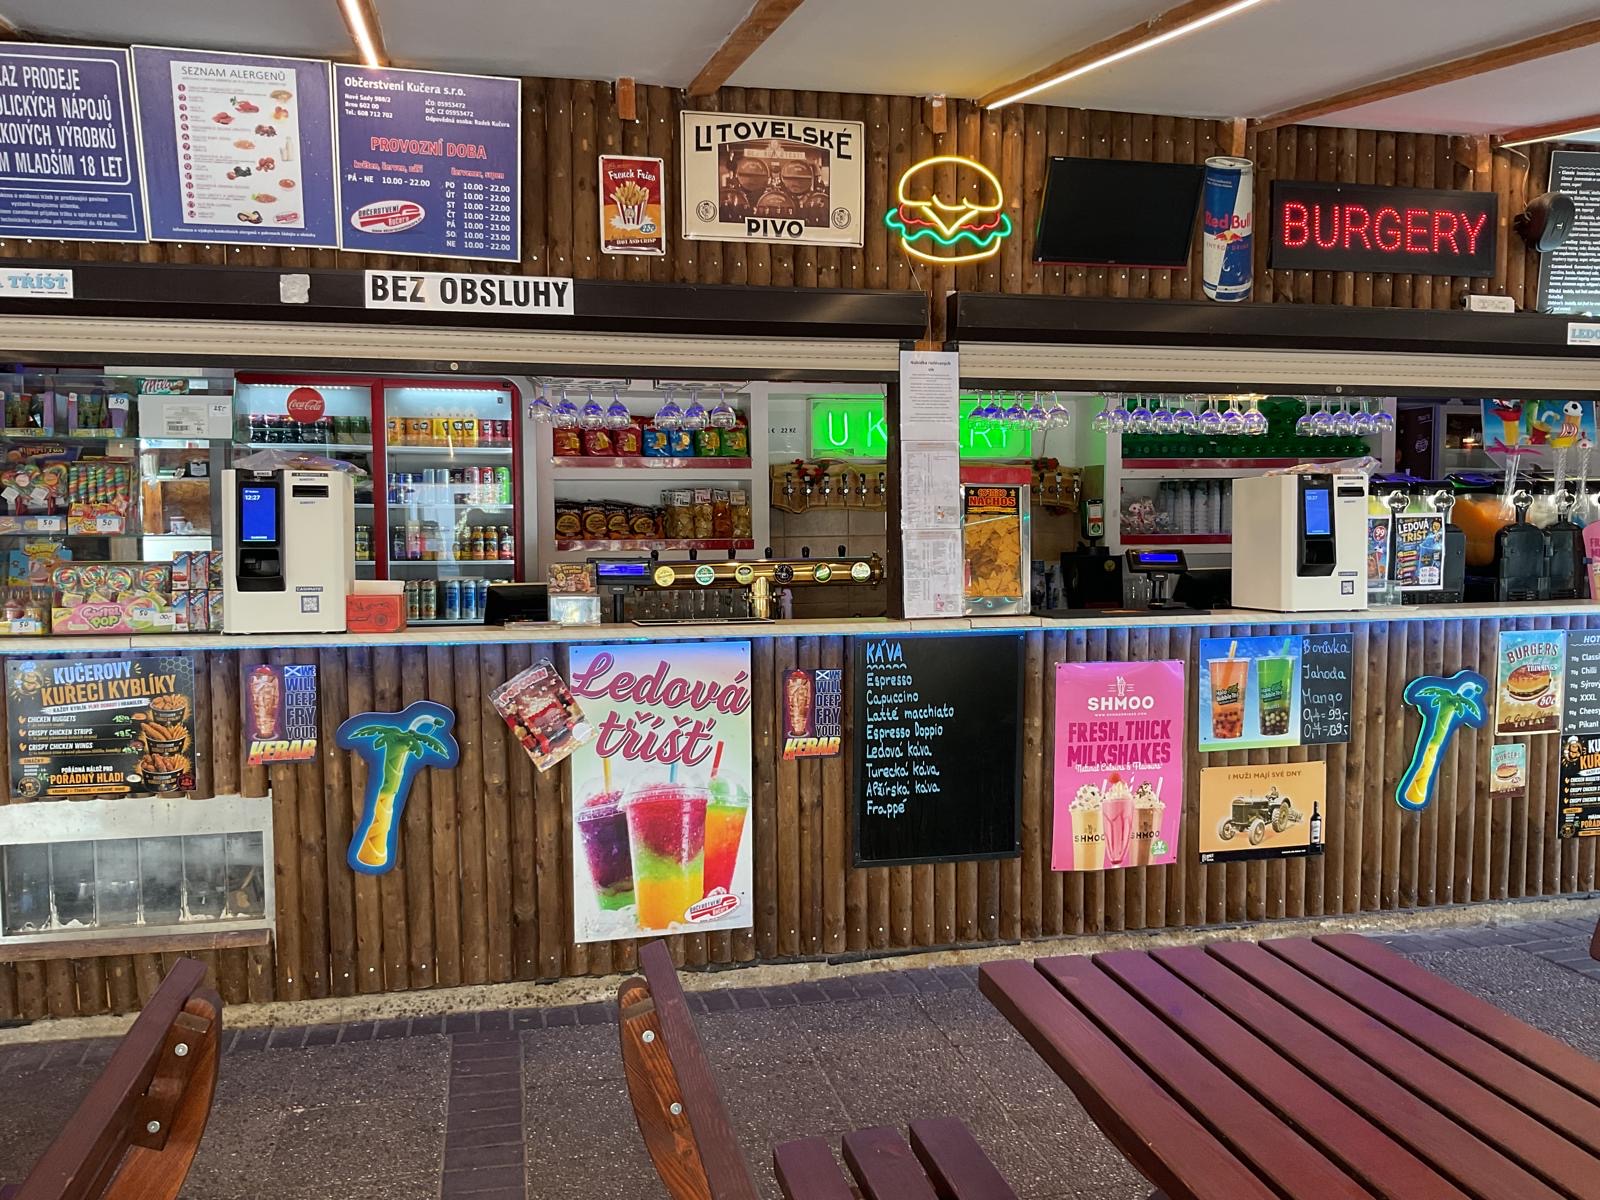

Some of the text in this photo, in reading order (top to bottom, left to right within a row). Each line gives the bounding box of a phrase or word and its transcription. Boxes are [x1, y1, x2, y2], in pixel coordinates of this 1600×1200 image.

[0, 64, 80, 90] AZ PRODEJE
[181, 66, 226, 78] SEZNAM
[230, 69, 286, 81] ALERGENŮ
[344, 76, 466, 96] Občerstvení Kučera s.r.o.
[61, 92, 112, 121] NÁPOJŮ
[437, 101, 466, 109] 05953472
[0, 119, 116, 149] KOVÝCH VÝROBKŮ
[695, 121, 852, 160] LITOVELSKÉ
[370, 136, 488, 160] PROVOZNÍ DOBA
[15, 148, 75, 176] MLADŠÍM
[80, 155, 95, 176] 18
[101, 156, 122, 177] LET
[354, 160, 424, 173] květen, červen, září
[348, 174, 431, 188] PÁ NE 10.00 22.00
[451, 167, 505, 180] červenec, srpen
[608, 168, 656, 181] French Fries
[445, 181, 510, 194] PO 10.00 22.00
[446, 190, 510, 204] ÚT 10.00 22.00
[447, 201, 510, 214] ST 10.00 22.00
[447, 210, 510, 223] ČT 10.00 22.00
[1205, 210, 1251, 229] Red Bull
[447, 220, 510, 232] PÁ 10.00 23.00
[747, 218, 804, 239] PIVO
[1283, 202, 1489, 256] BURGERY
[446, 230, 510, 242] SO 10.00 23.00
[447, 240, 510, 252] NE 10.00 22.00
[371, 275, 569, 308] BEZ OBSLUHY
[114, 397, 125, 405] 50
[288, 400, 322, 412] Coca-Cola
[828, 411, 849, 447] U
[969, 496, 1016, 507] NACHOS
[43, 519, 53, 527] 50
[103, 519, 113, 527] 50
[1398, 518, 1430, 534] LEDOVÁ
[1375, 528, 1384, 537] 99
[91, 615, 119, 628] POP
[866, 639, 903, 664] KÁVA
[1507, 643, 1558, 664] BURGERS
[53, 661, 132, 684] KUČEROVY
[1303, 664, 1346, 680] Jahoda
[42, 673, 176, 706] KUŘECÍ KYBLÍKY
[286, 677, 316, 692] WILL
[571, 652, 750, 716] Ledová
[816, 680, 842, 694] WILL
[866, 673, 913, 690] Espresso
[286, 692, 316, 706] DEEP
[816, 694, 842, 707] DEEP
[866, 690, 919, 707] Capuccino
[1087, 696, 1154, 711] SHMOO
[1302, 688, 1342, 708] Mango
[286, 707, 316, 726] FRY
[816, 707, 841, 724] FRY
[904, 703, 954, 719] macchiato
[28, 727, 93, 737] CRISPY CHICKEN STRIPS
[287, 726, 317, 740] YOUR
[595, 710, 717, 766] tříšť
[816, 725, 841, 737] YOUR
[866, 721, 943, 741] Espresso Doppio
[248, 740, 317, 765] KEBAB
[783, 737, 841, 760] KEBAB
[866, 741, 932, 759] Ledová káva
[1067, 742, 1171, 768] MILKSHAKES
[866, 761, 940, 778] Turecká káva
[1075, 764, 1099, 773] Natural
[1101, 763, 1126, 772] Colours
[1232, 772, 1252, 780] MUŽI
[1253, 771, 1270, 779] MAJÍ
[1272, 770, 1284, 778] SVÉ
[50, 772, 124, 785] POŘÁDNÝ HLAD!
[915, 780, 940, 793] káva
[867, 798, 907, 818] Frappé
